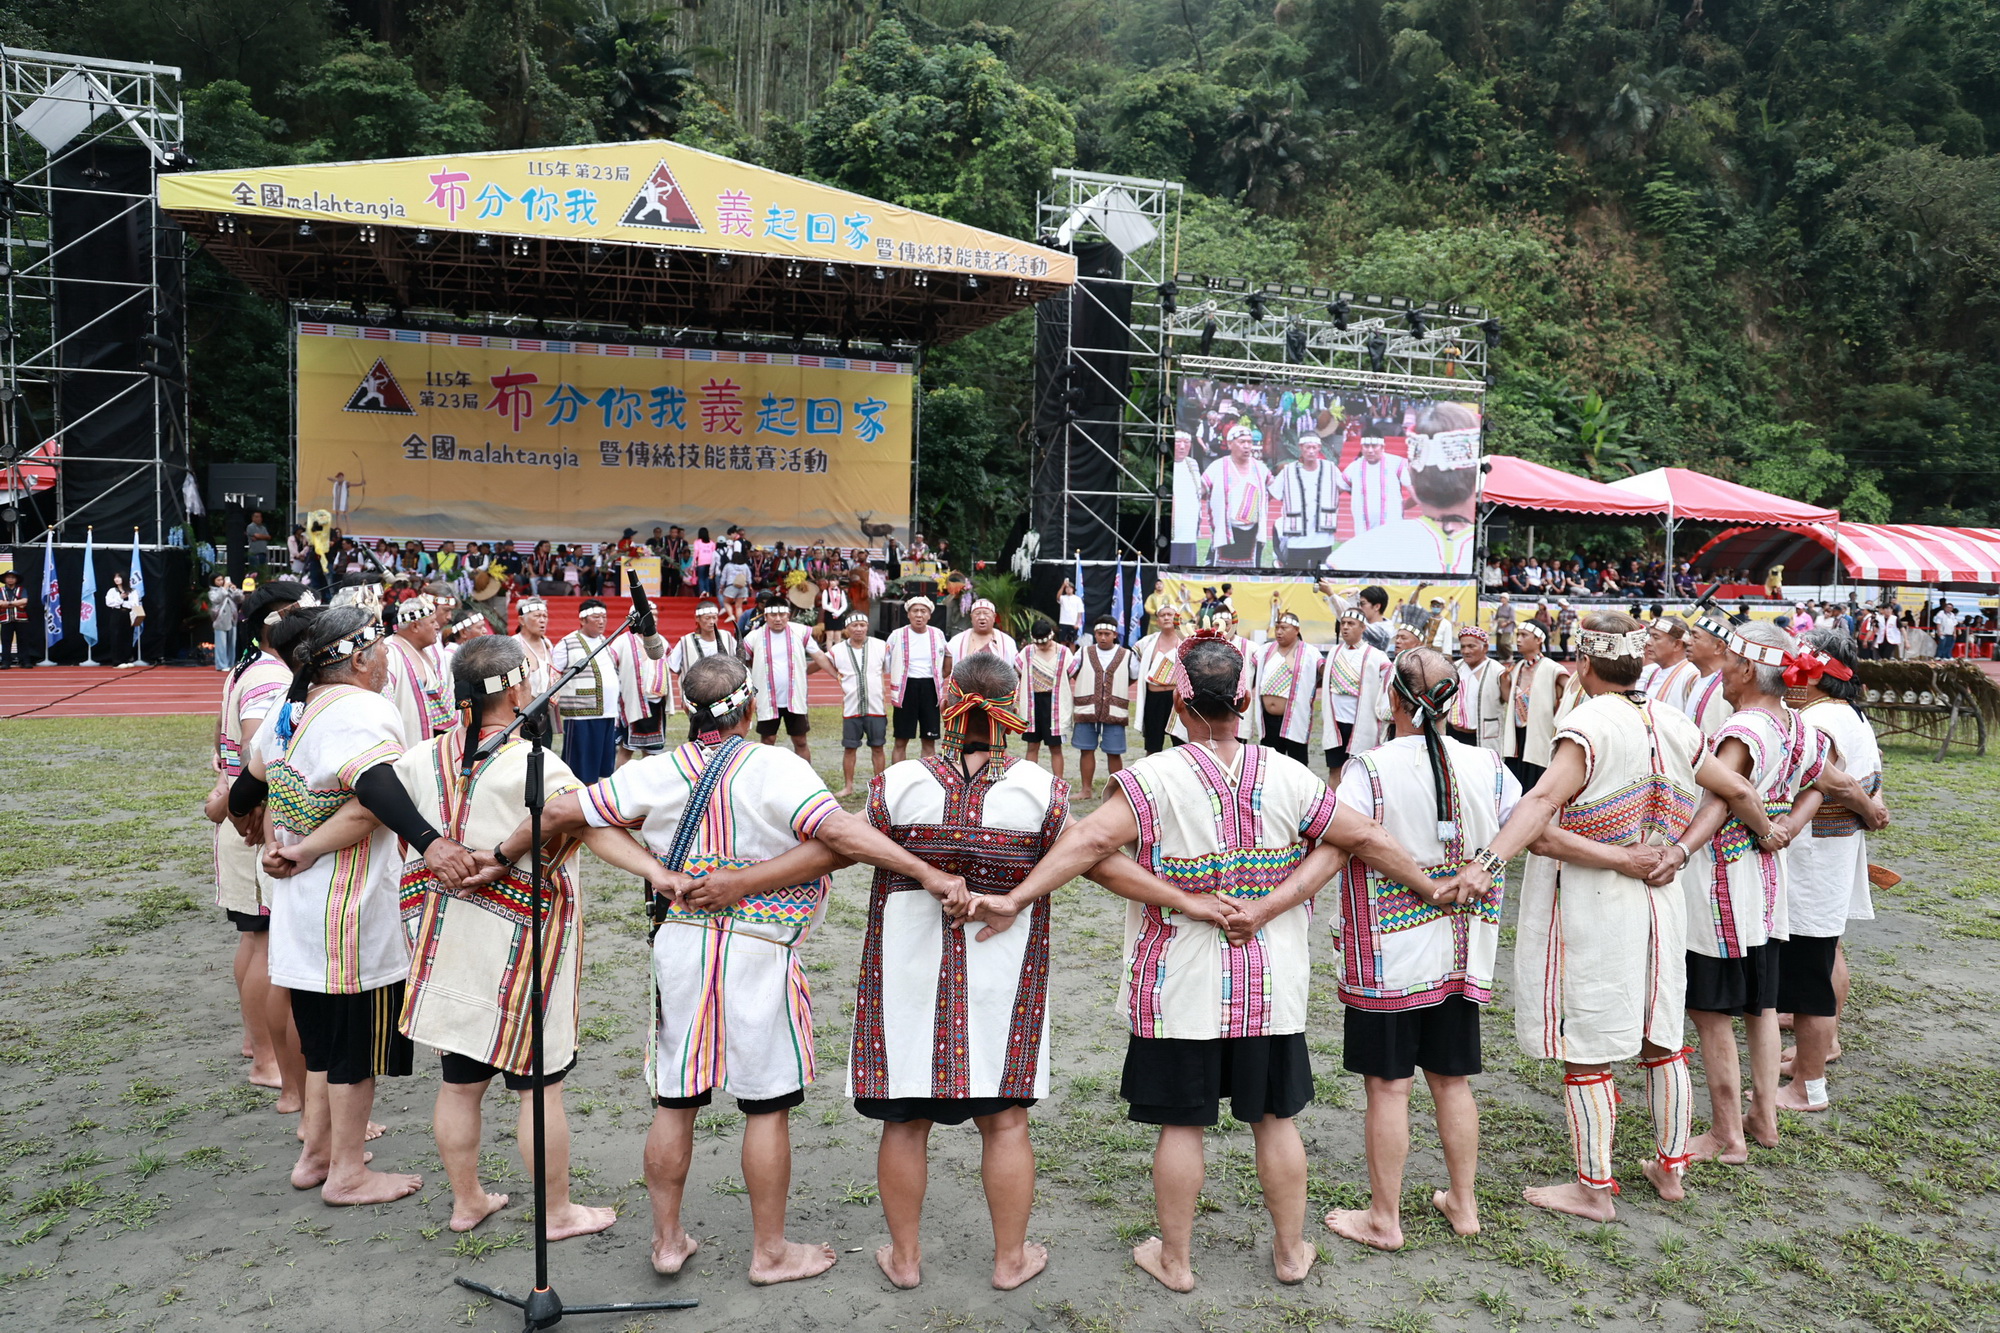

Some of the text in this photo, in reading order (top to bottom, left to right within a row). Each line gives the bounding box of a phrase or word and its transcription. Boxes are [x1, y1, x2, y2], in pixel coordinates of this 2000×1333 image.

[424, 166, 598, 225] 布分你我
[717, 189, 872, 249] 義起回家
[876, 237, 1047, 276] 暨傳統技能競賽活動
[425, 371, 472, 388] 115年
[419, 391, 478, 409] 第23屆
[600, 441, 828, 473] 暨傳統技能競賽活動
